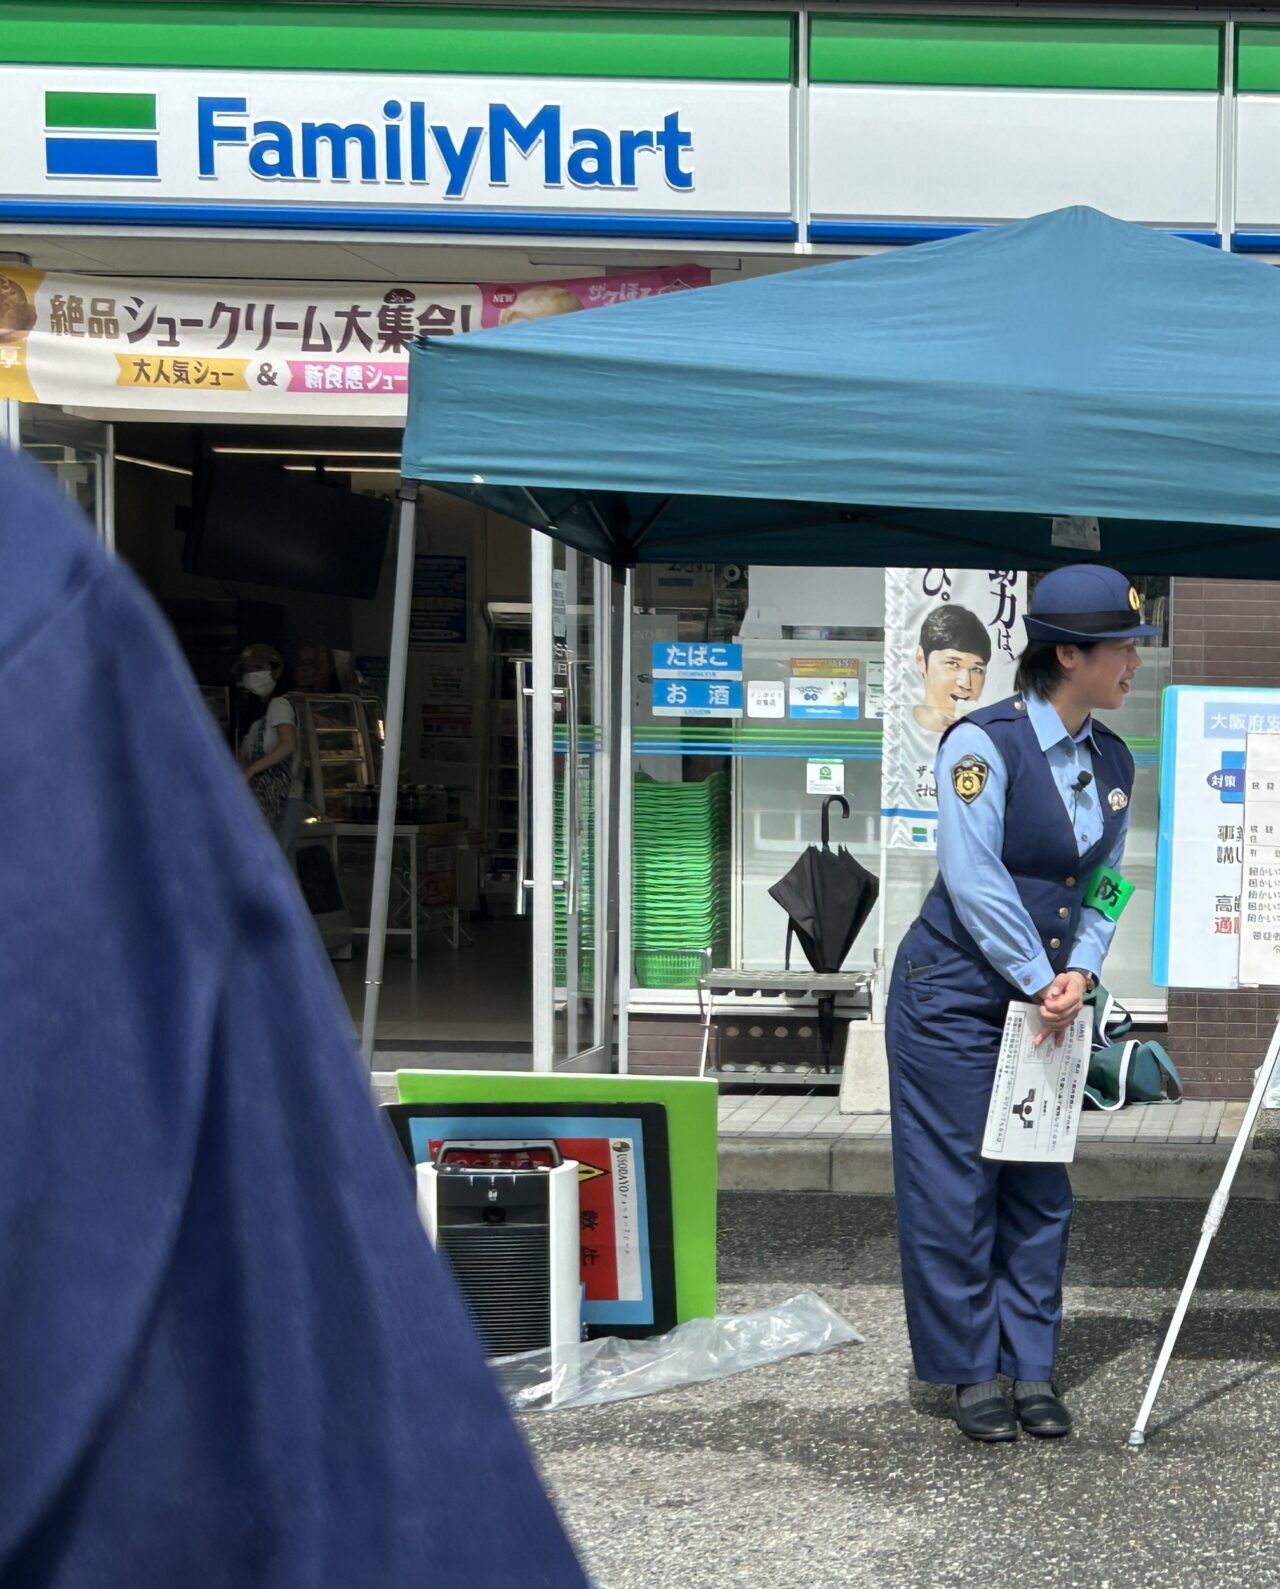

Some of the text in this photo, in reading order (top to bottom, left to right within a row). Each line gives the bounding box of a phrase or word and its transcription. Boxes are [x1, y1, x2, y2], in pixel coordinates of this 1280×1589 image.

[198, 97, 695, 197] FamilyMart
[492, 292, 515, 303] NEW
[133, 358, 235, 386] 大人気シュー
[304, 364, 408, 390] 新食感シュー
[666, 644, 729, 667] たばこ
[666, 683, 730, 706] お酒
